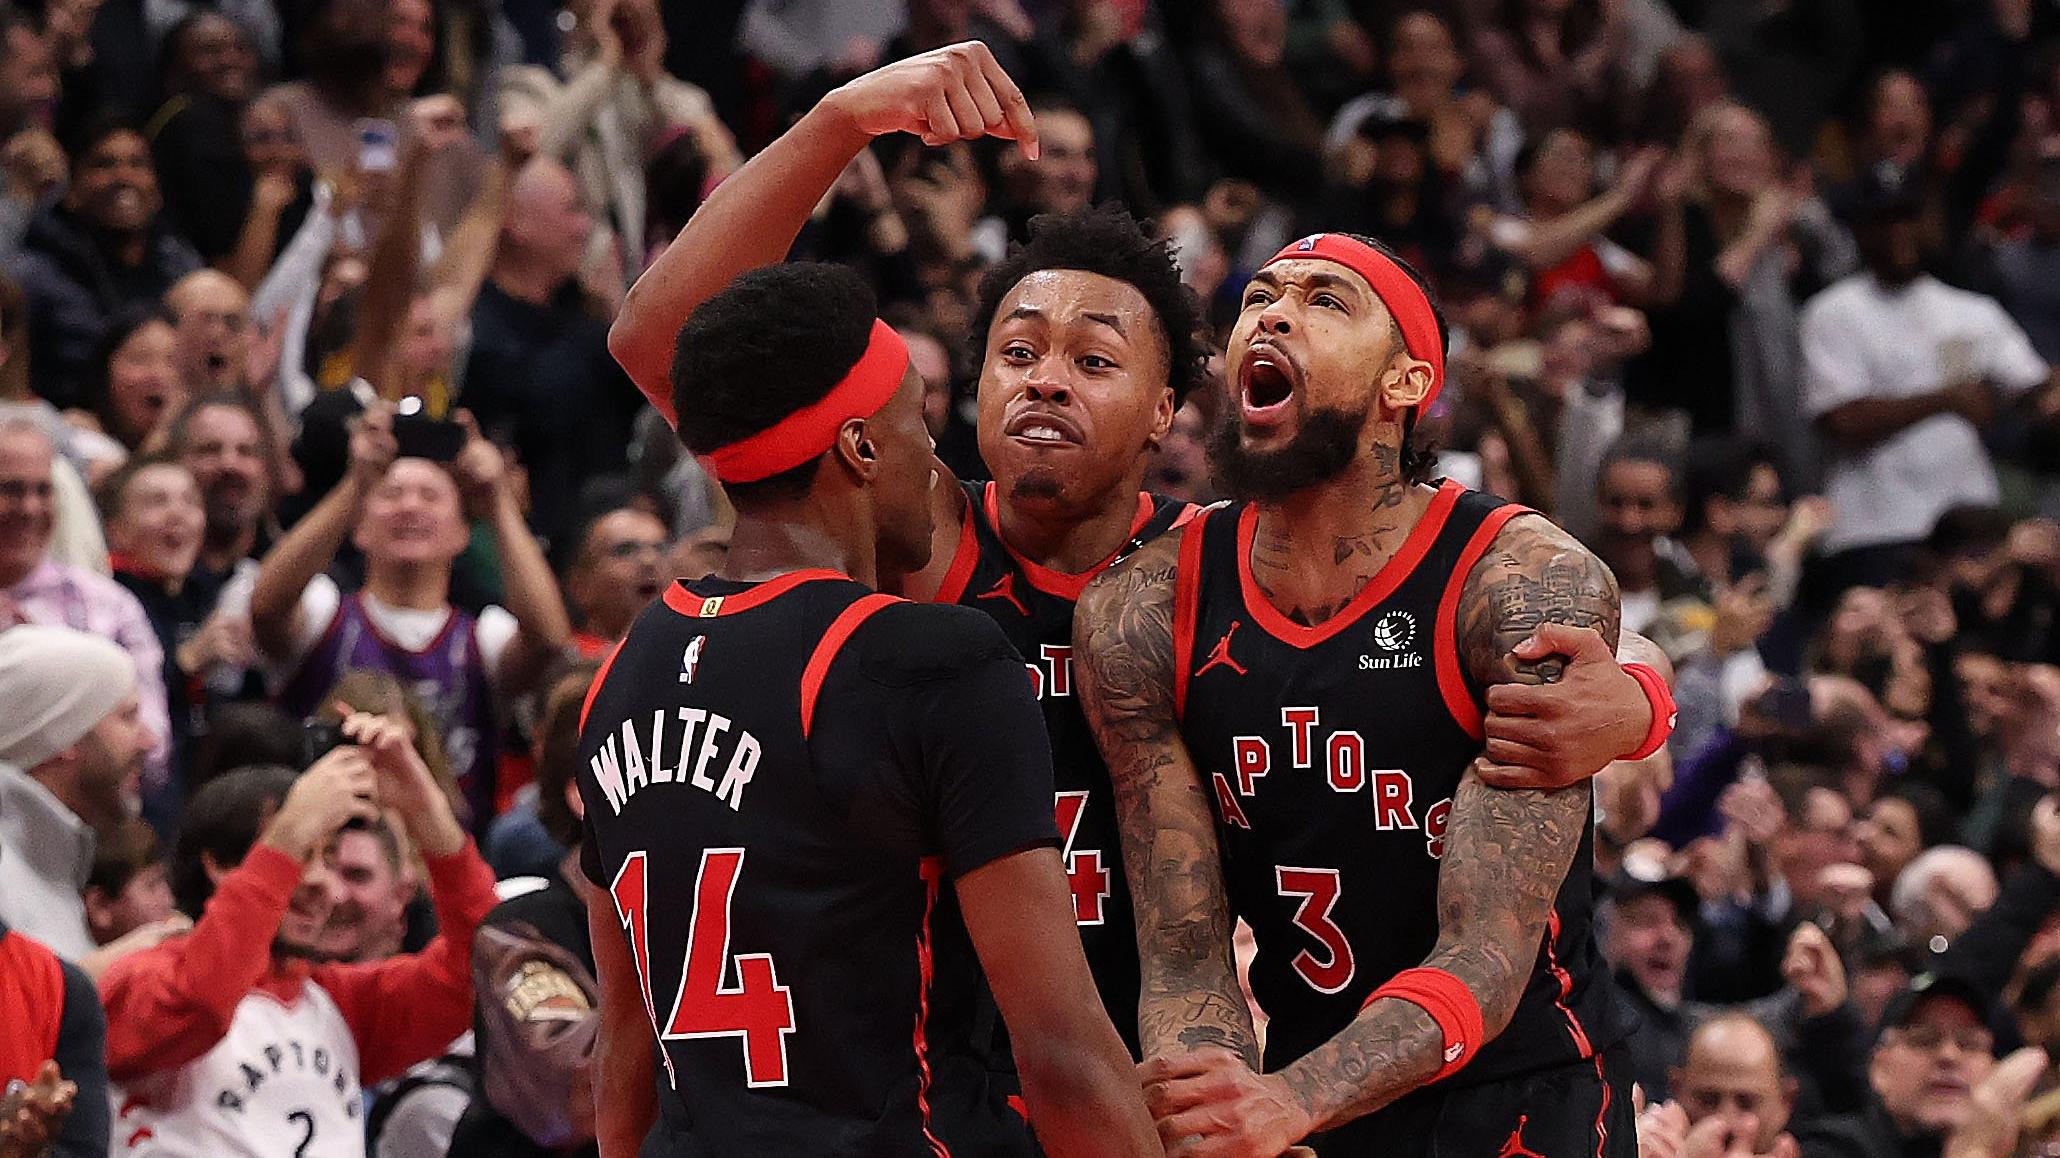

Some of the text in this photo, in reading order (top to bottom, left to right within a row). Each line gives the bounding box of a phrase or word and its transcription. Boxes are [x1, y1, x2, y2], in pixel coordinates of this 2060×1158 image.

[1358, 651, 1423, 670] Sun Life
[590, 706, 762, 816] WALTER
[610, 847, 796, 1090] 14
[1274, 864, 1356, 995] 3
